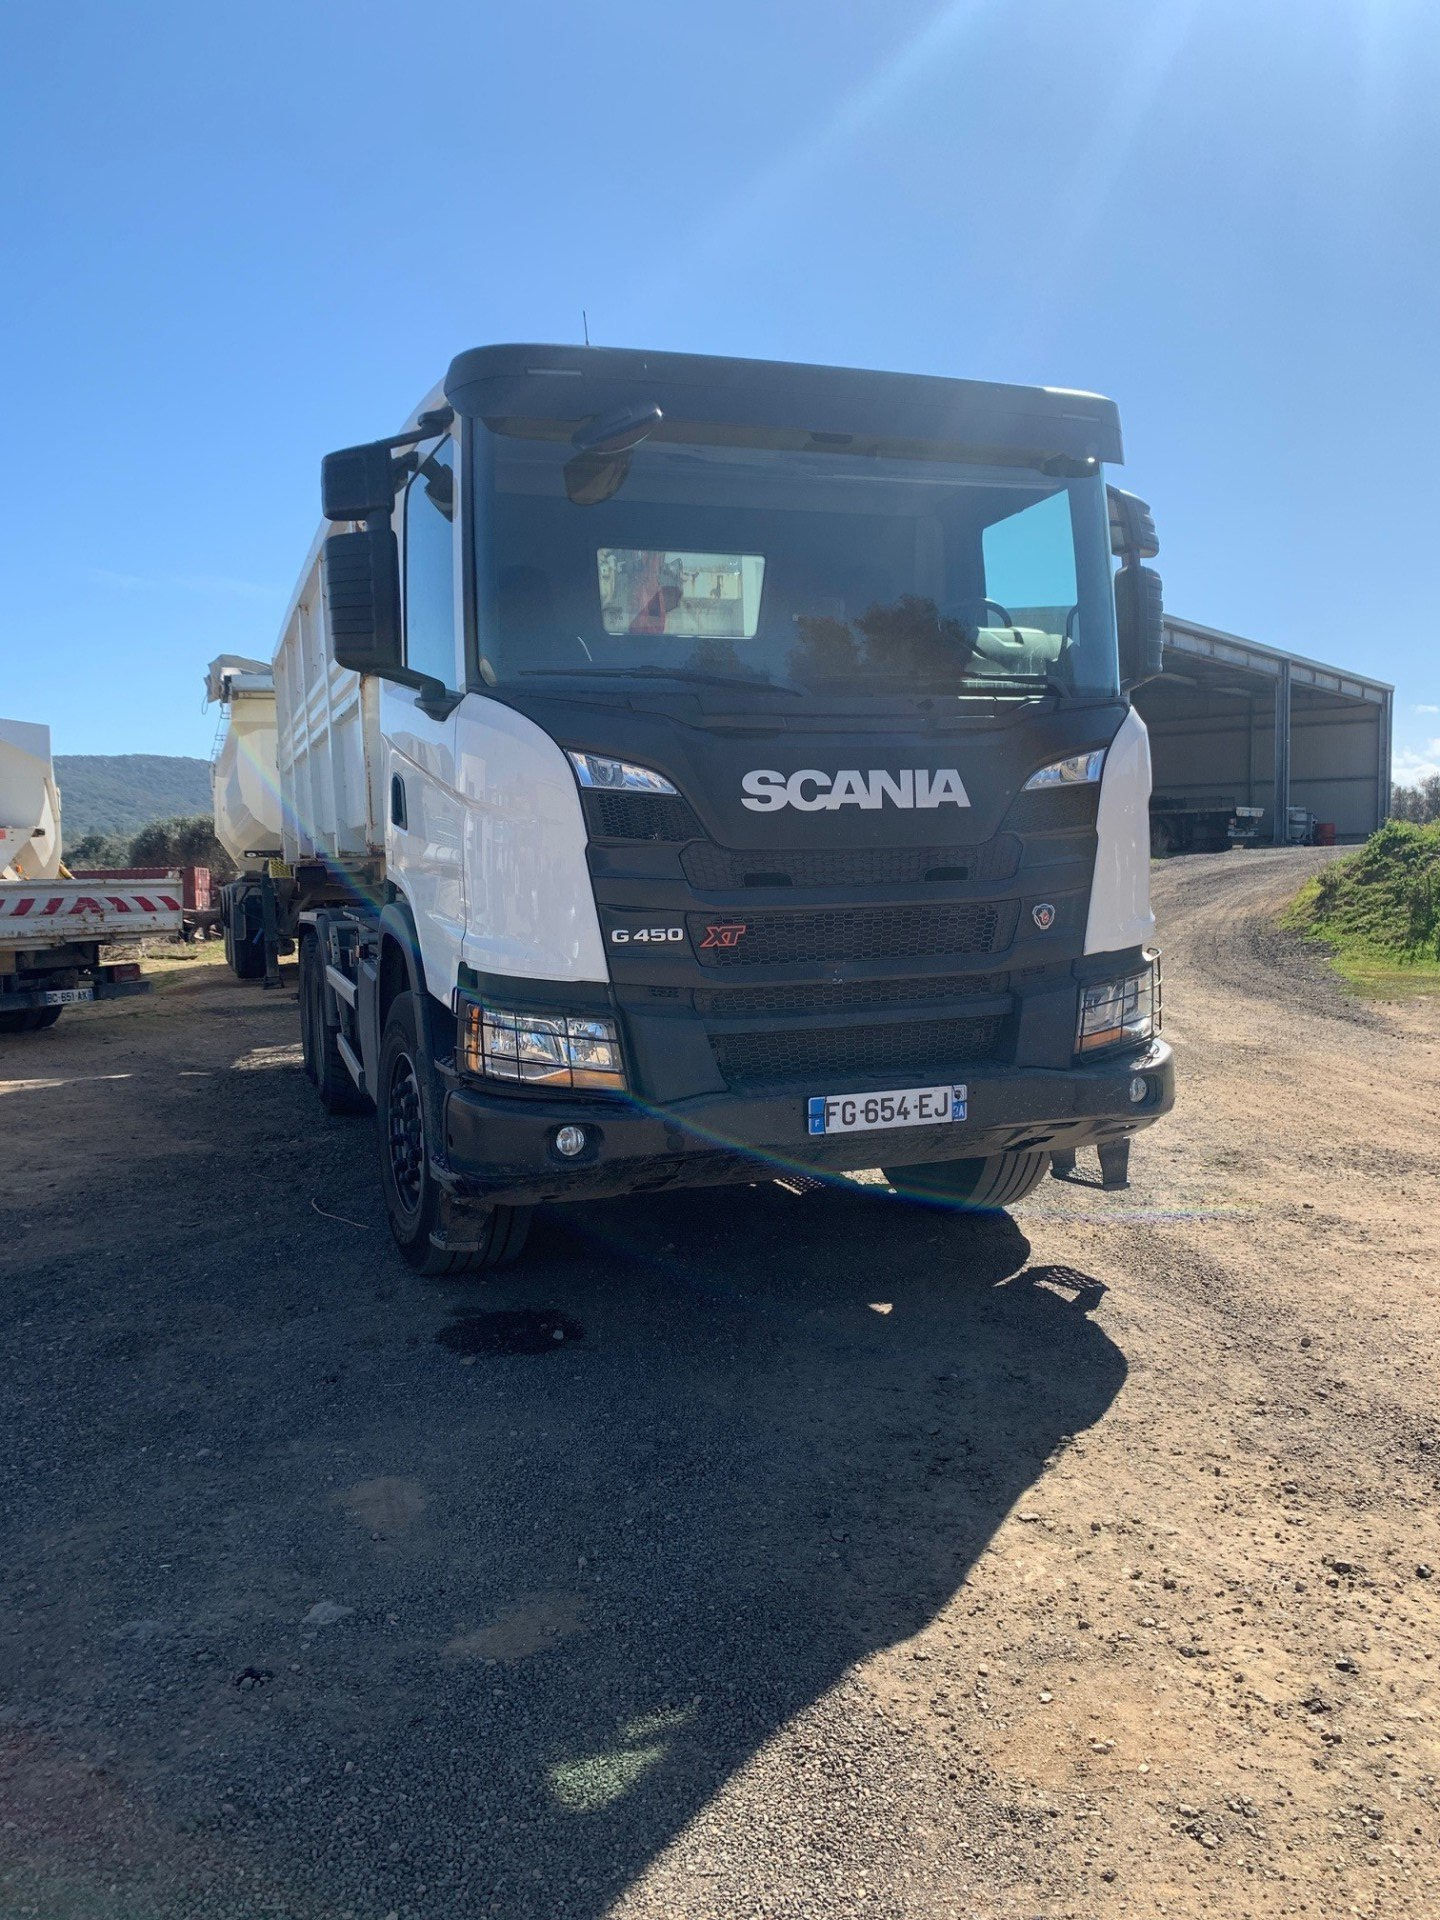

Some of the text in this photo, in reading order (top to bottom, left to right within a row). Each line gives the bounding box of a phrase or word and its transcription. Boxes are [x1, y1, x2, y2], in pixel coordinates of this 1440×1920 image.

[741, 769, 971, 812] SCANIA
[611, 928, 684, 943] G 450
[700, 925, 746, 948] XT
[825, 1093, 948, 1127] FG-654-EJ
